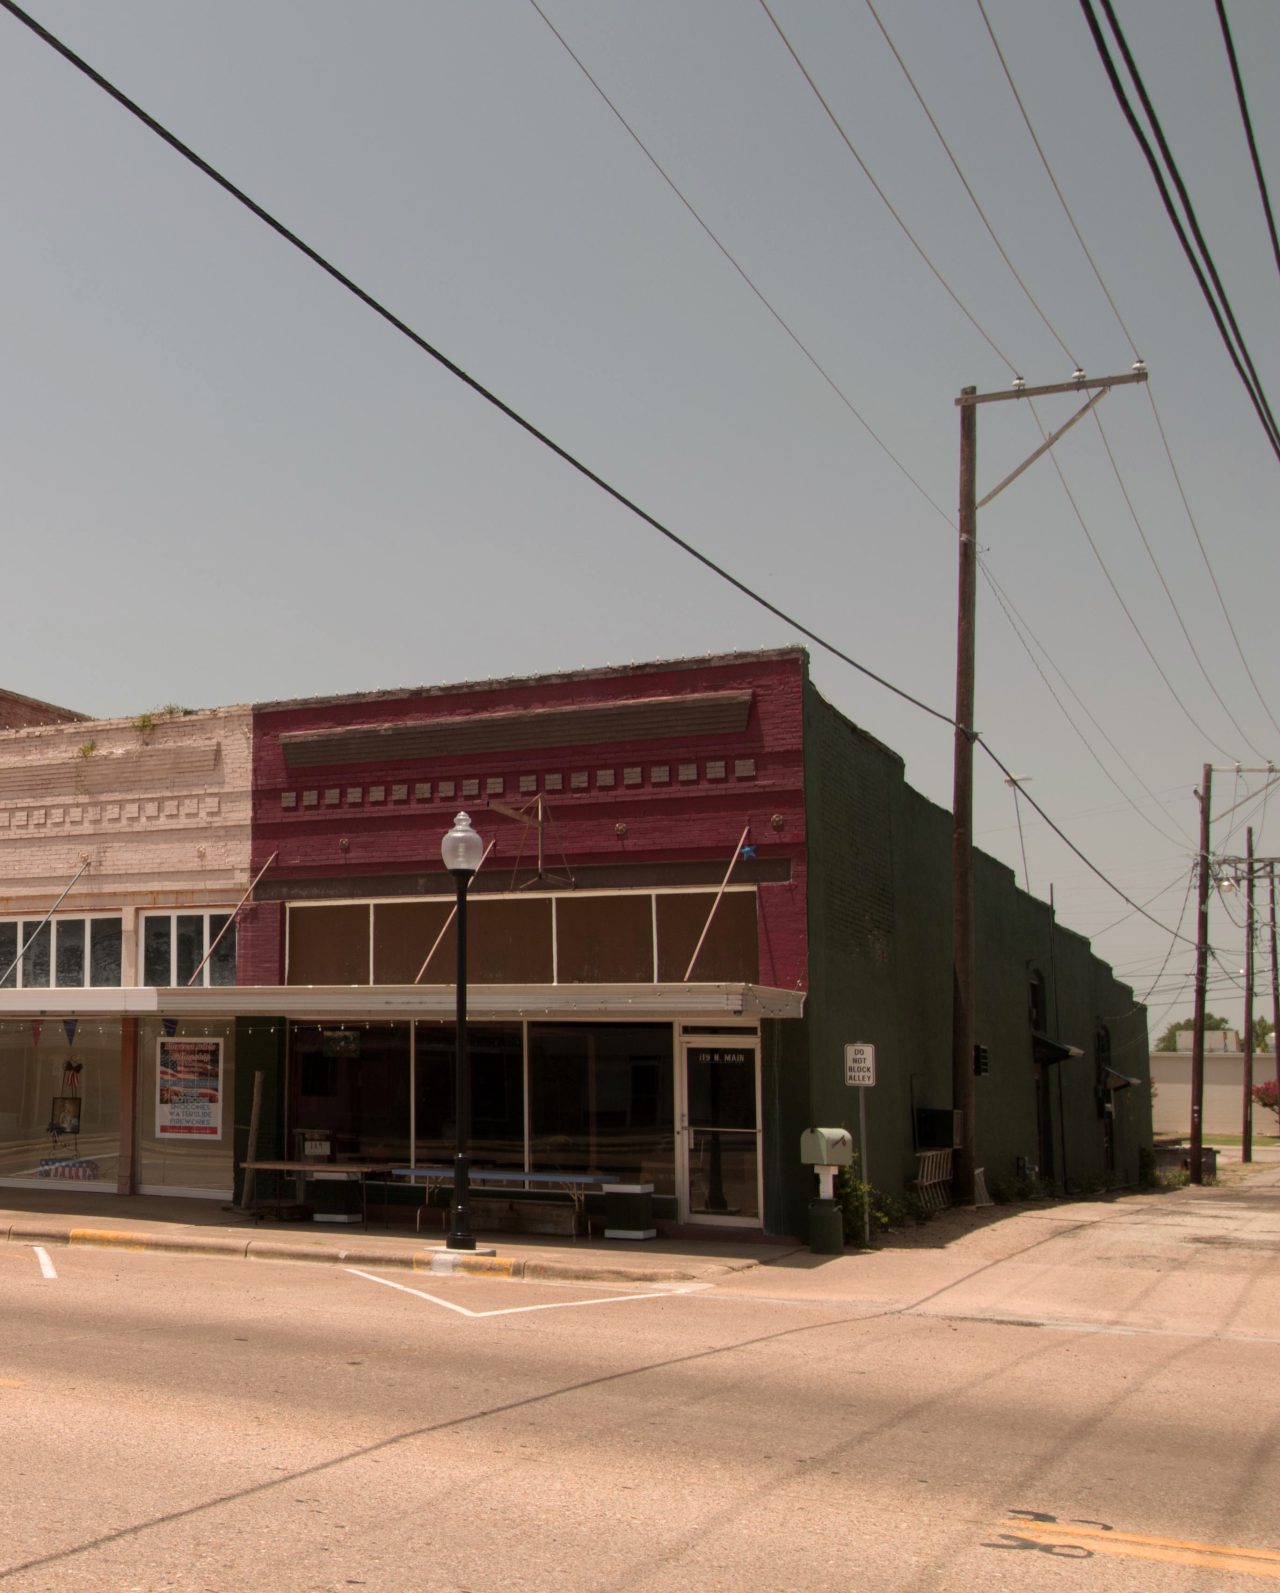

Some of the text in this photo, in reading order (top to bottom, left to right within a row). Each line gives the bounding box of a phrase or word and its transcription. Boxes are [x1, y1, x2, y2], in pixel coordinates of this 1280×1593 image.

[854, 1048, 865, 1056] DO
[724, 1053, 745, 1063] MAIN
[852, 1057, 866, 1065] NOT
